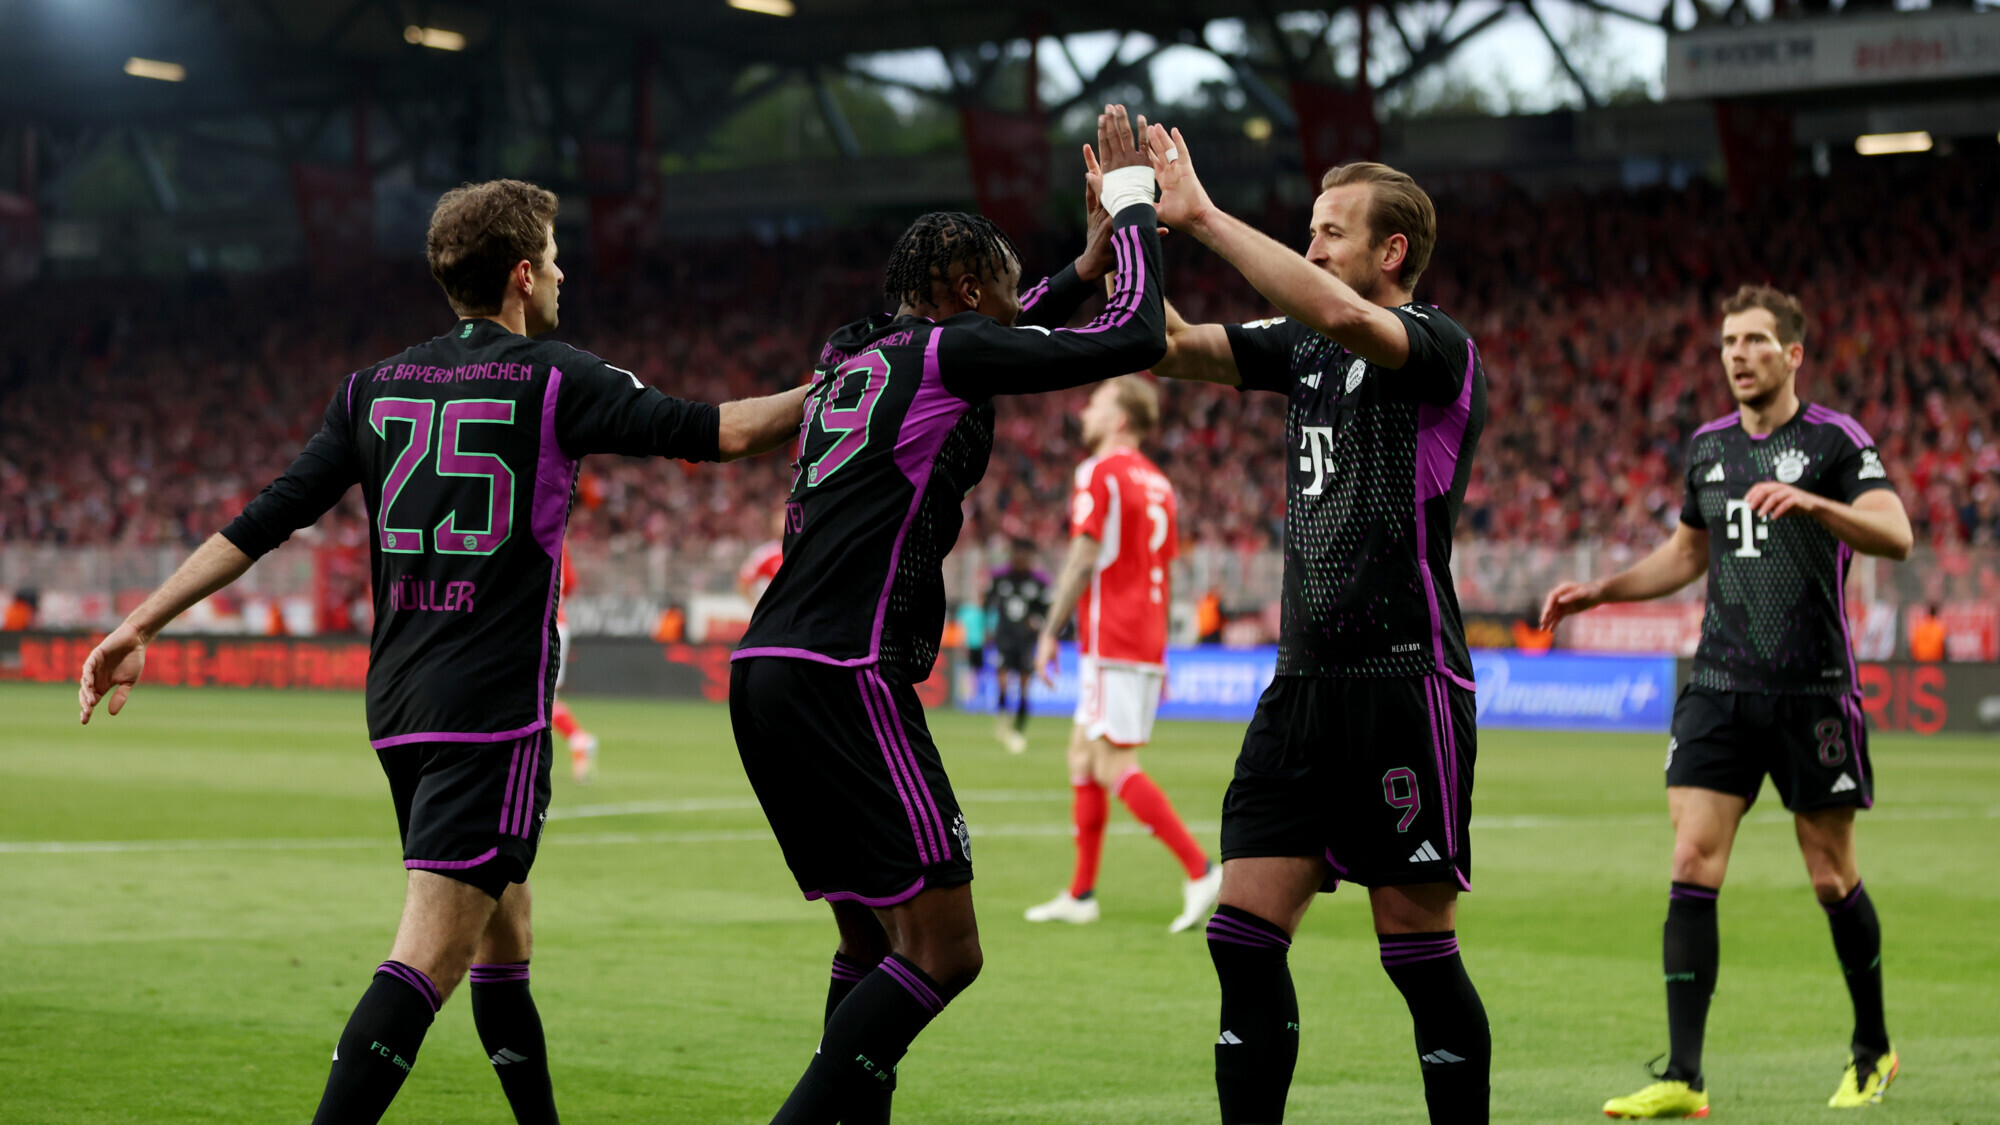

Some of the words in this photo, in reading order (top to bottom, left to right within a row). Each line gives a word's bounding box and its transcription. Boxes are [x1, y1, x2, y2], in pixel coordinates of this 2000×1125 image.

[372, 364, 393, 383] FC
[393, 363, 453, 384] BAYERN
[369, 396, 516, 555] 25
[390, 575, 476, 613] MÜLLER
[1814, 718, 1847, 767] 8
[1382, 766, 1421, 833] 9
[370, 1040, 391, 1057] FC
